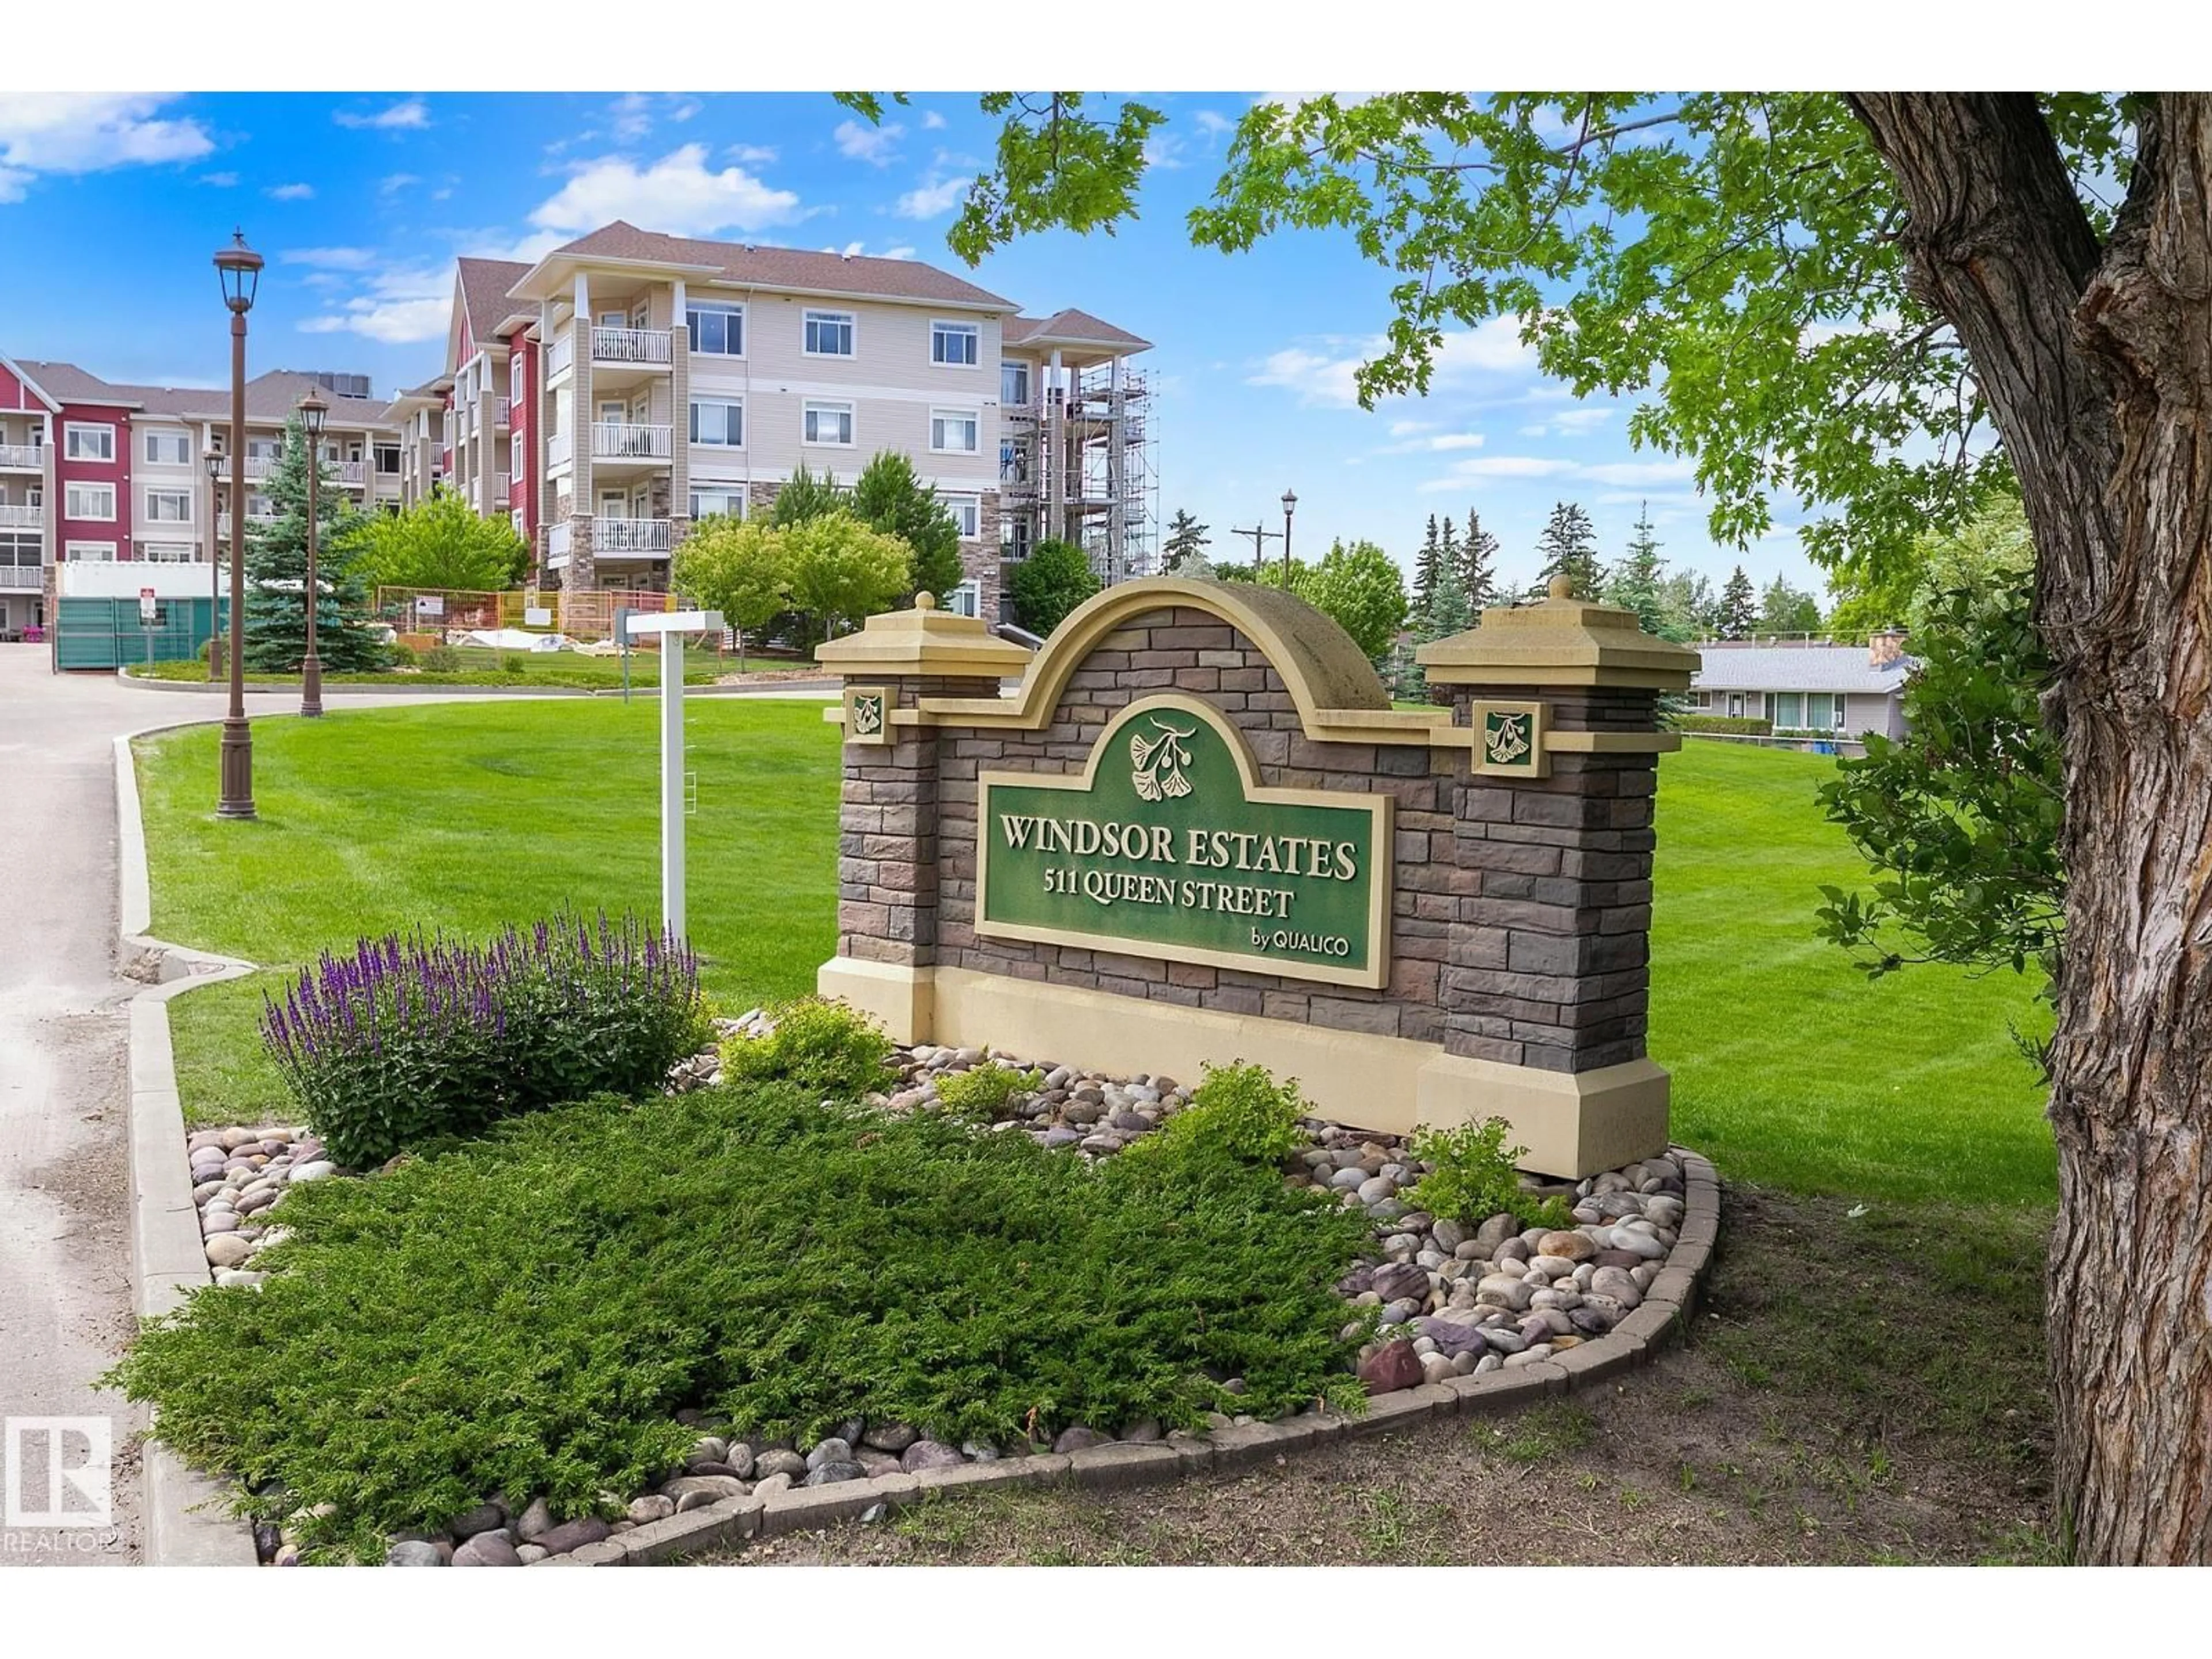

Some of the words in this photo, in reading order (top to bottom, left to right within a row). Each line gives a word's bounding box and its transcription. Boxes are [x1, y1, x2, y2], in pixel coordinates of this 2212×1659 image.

[1000, 815, 1176, 863] WINDSOR
[1185, 830, 1357, 881] ESTATES
[1044, 869, 1079, 894] 511
[1084, 870, 1177, 905] QUEEN
[1181, 880, 1295, 918] STREET
[1252, 927, 1271, 950] by
[1274, 930, 1349, 956] QUALICO
